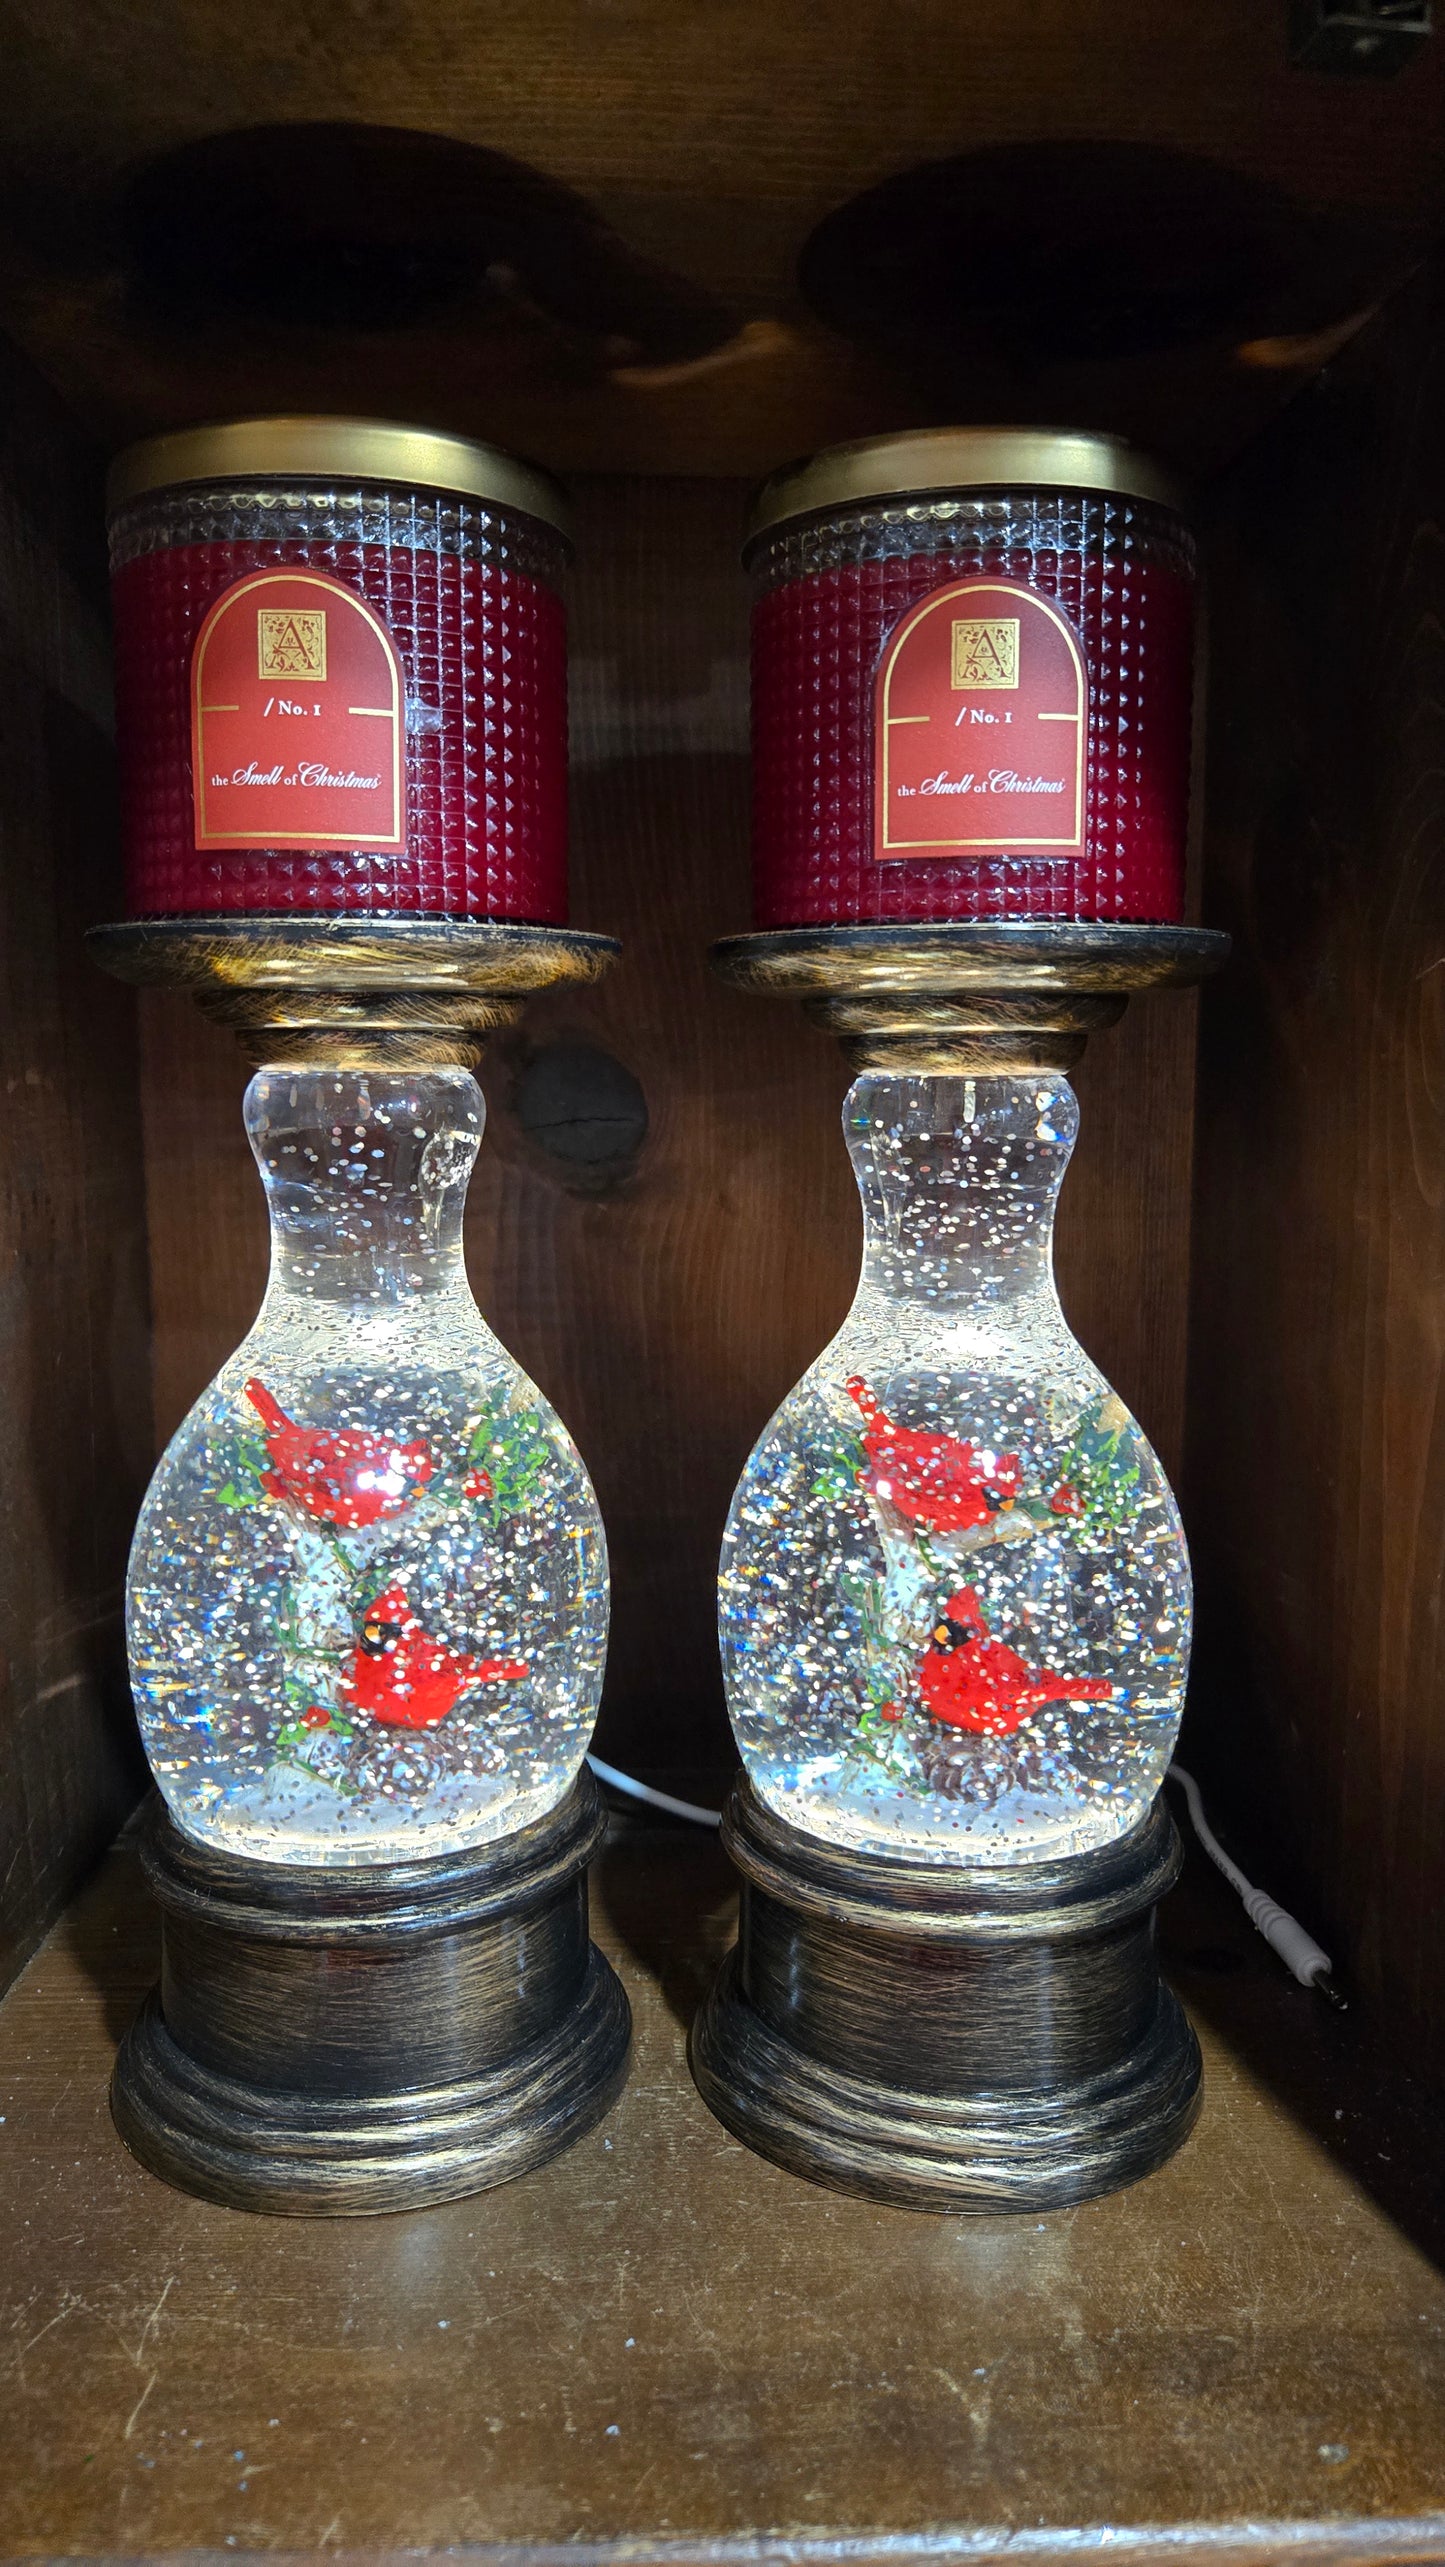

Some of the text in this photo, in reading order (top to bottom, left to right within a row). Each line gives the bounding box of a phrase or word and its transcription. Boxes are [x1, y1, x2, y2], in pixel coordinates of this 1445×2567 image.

[264, 618, 316, 671] A
[961, 628, 1008, 680] A
[278, 700, 308, 716] No.
[970, 709, 1000, 724] No.
[212, 774, 229, 786] the
[231, 761, 284, 786] Smell
[284, 773, 298, 786] of
[897, 784, 917, 797] the
[919, 770, 975, 796] Smell
[973, 781, 989, 794] of
